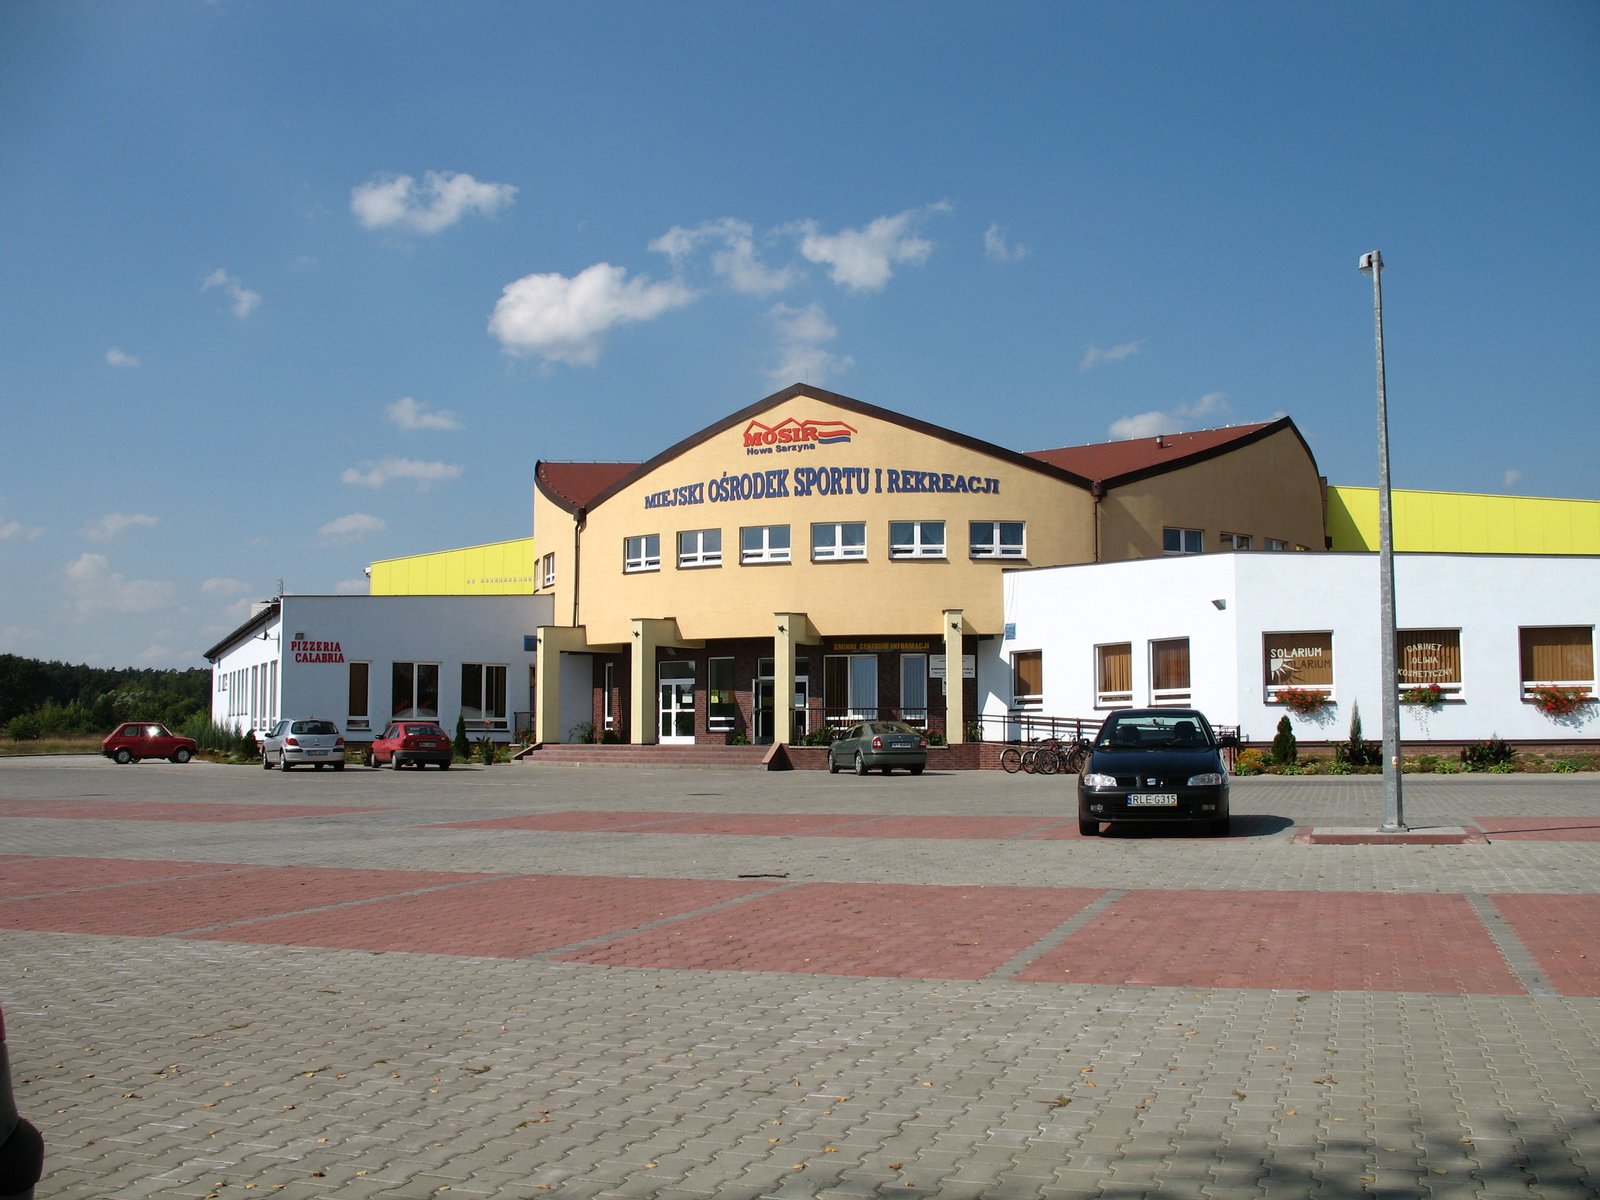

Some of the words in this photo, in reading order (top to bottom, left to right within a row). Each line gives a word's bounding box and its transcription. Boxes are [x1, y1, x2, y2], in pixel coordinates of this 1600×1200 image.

[747, 447, 773, 455] Nowa
[776, 443, 815, 452] Sarzyna
[644, 483, 704, 509] MIEJSKI
[708, 471, 789, 503] OŚRODEK
[794, 467, 870, 496] SPORTU
[875, 468, 882, 494] I
[887, 469, 1000, 495] REKREACJI
[291, 641, 341, 652] PIZZERIA
[1407, 643, 1442, 652] GABINET
[1270, 647, 1322, 658] SOLARIUM
[295, 653, 345, 663] CALABRIA
[1398, 668, 1453, 677] KOSMETYCZNY
[1132, 795, 1152, 804] RLE
